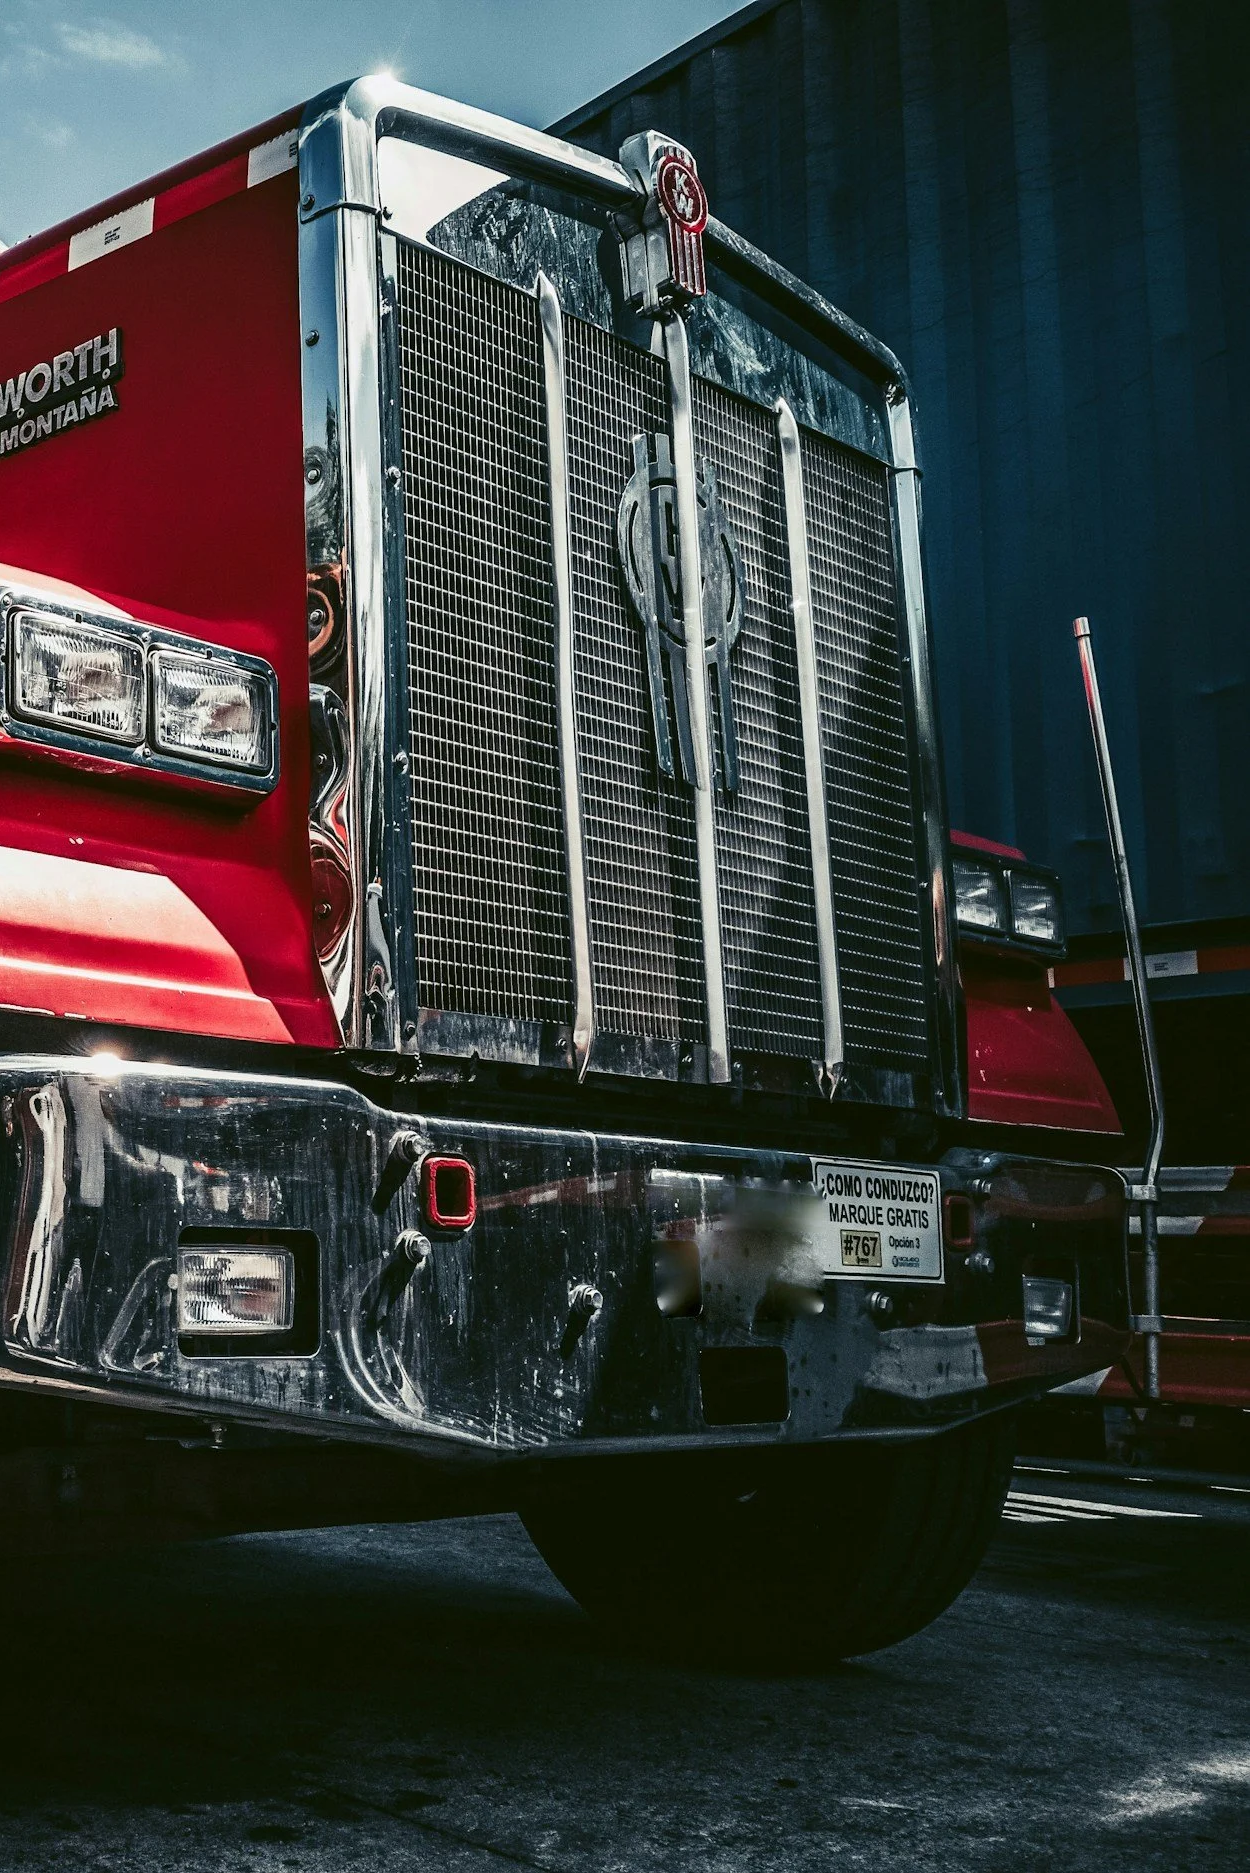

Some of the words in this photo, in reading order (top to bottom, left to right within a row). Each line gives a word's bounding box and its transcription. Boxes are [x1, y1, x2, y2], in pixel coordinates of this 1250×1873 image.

[0, 385, 118, 453] MONTAÑA
[865, 1177, 934, 1204] CONDUZCO?
[829, 1203, 883, 1226] MARQUE
[886, 1207, 929, 1229] GRATIS
[843, 1235, 878, 1257] #767
[889, 1235, 914, 1250] Opción
[915, 1237, 920, 1249] 3
